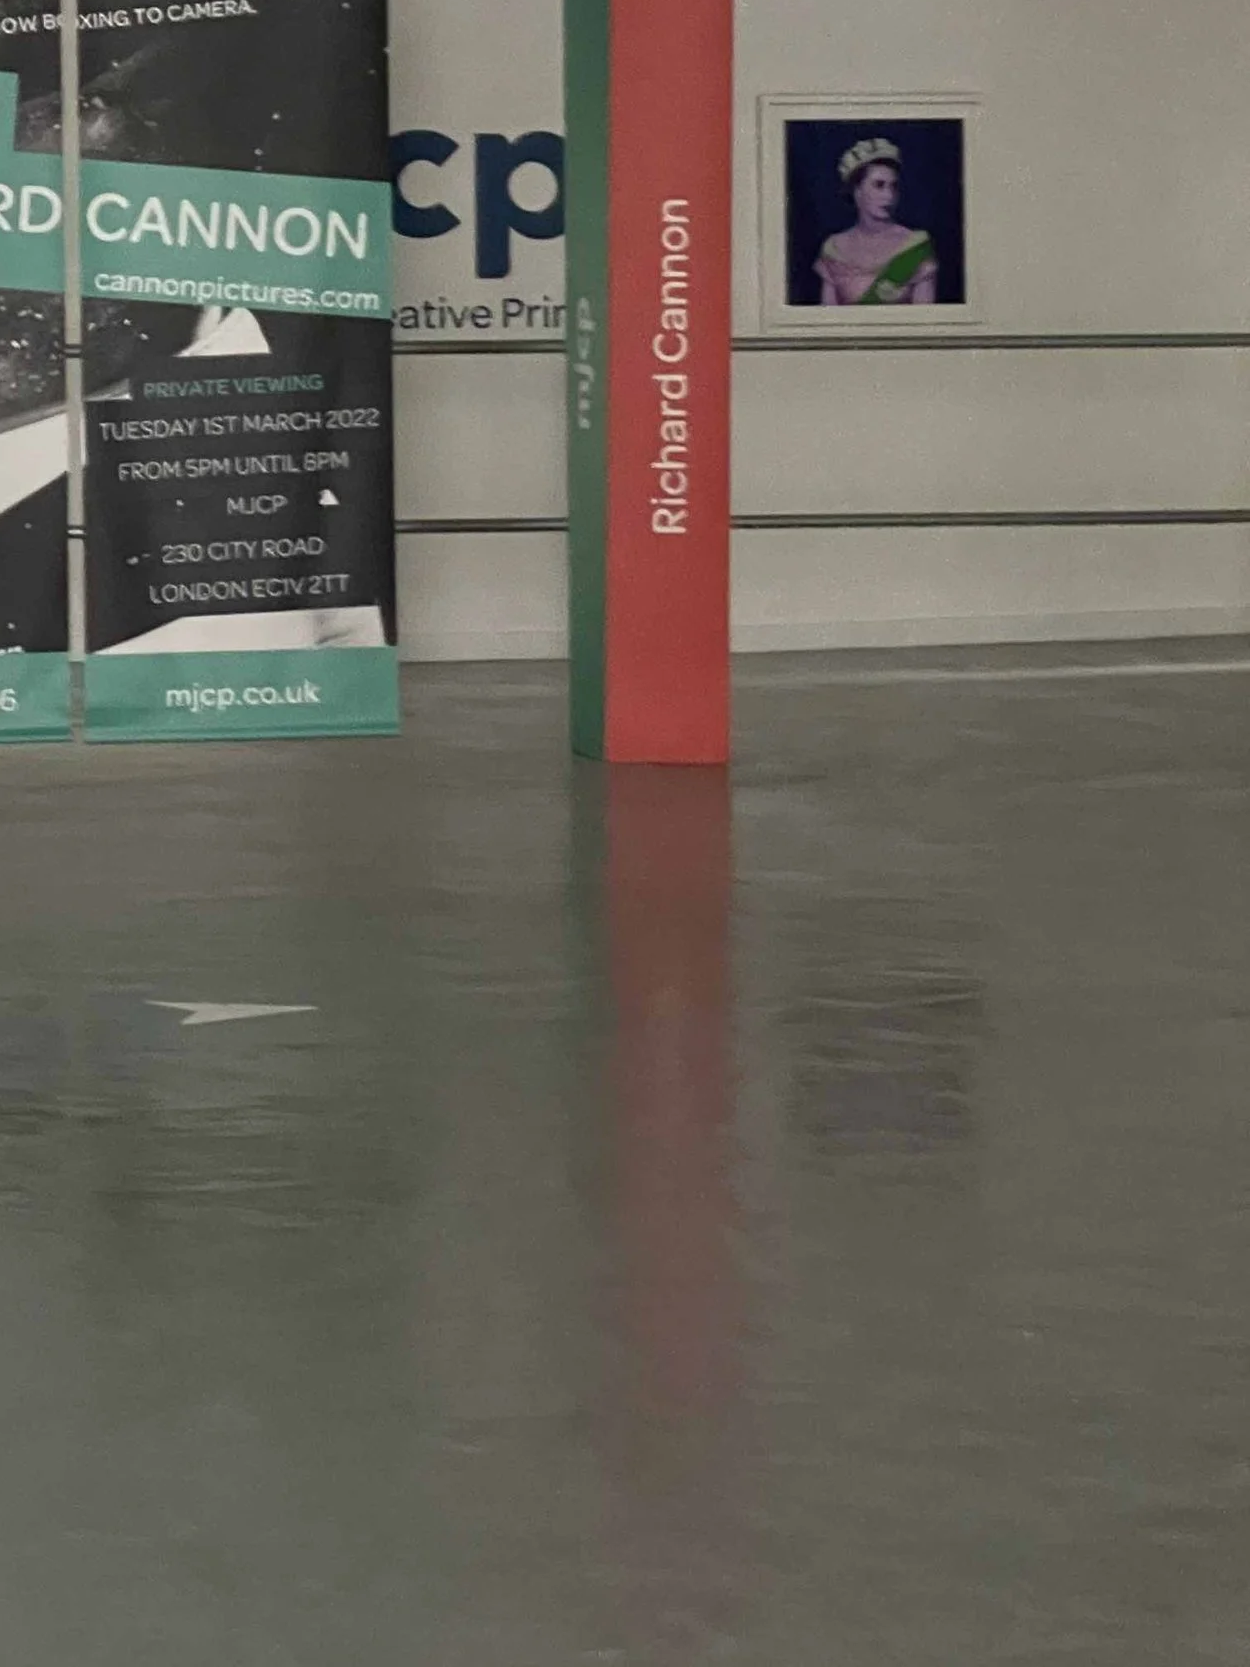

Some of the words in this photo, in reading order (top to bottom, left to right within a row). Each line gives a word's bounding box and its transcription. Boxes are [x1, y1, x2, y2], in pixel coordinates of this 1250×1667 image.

[136, 6, 163, 24] TO
[86, 192, 368, 259] CANNON
[94, 273, 380, 311] cannonpictures.com
[652, 198, 690, 364] Cannon
[143, 379, 231, 399] PRIVATE
[233, 374, 324, 394] VIEWING
[100, 418, 198, 441] TUESDAY
[203, 416, 239, 435] 1ST
[243, 411, 321, 432] MARCH
[326, 407, 380, 429] 2022
[118, 460, 183, 481] FROM
[184, 457, 231, 478] 5PM
[234, 454, 301, 475] UNTIL
[651, 373, 689, 535] Richard
[226, 495, 288, 514] MJCP
[161, 543, 203, 564] 230
[207, 540, 257, 561] CITY
[262, 536, 325, 558] ROAD
[150, 580, 248, 604] LONDON
[308, 574, 350, 594] 2TT
[166, 678, 322, 713] mjcp.co.uk
